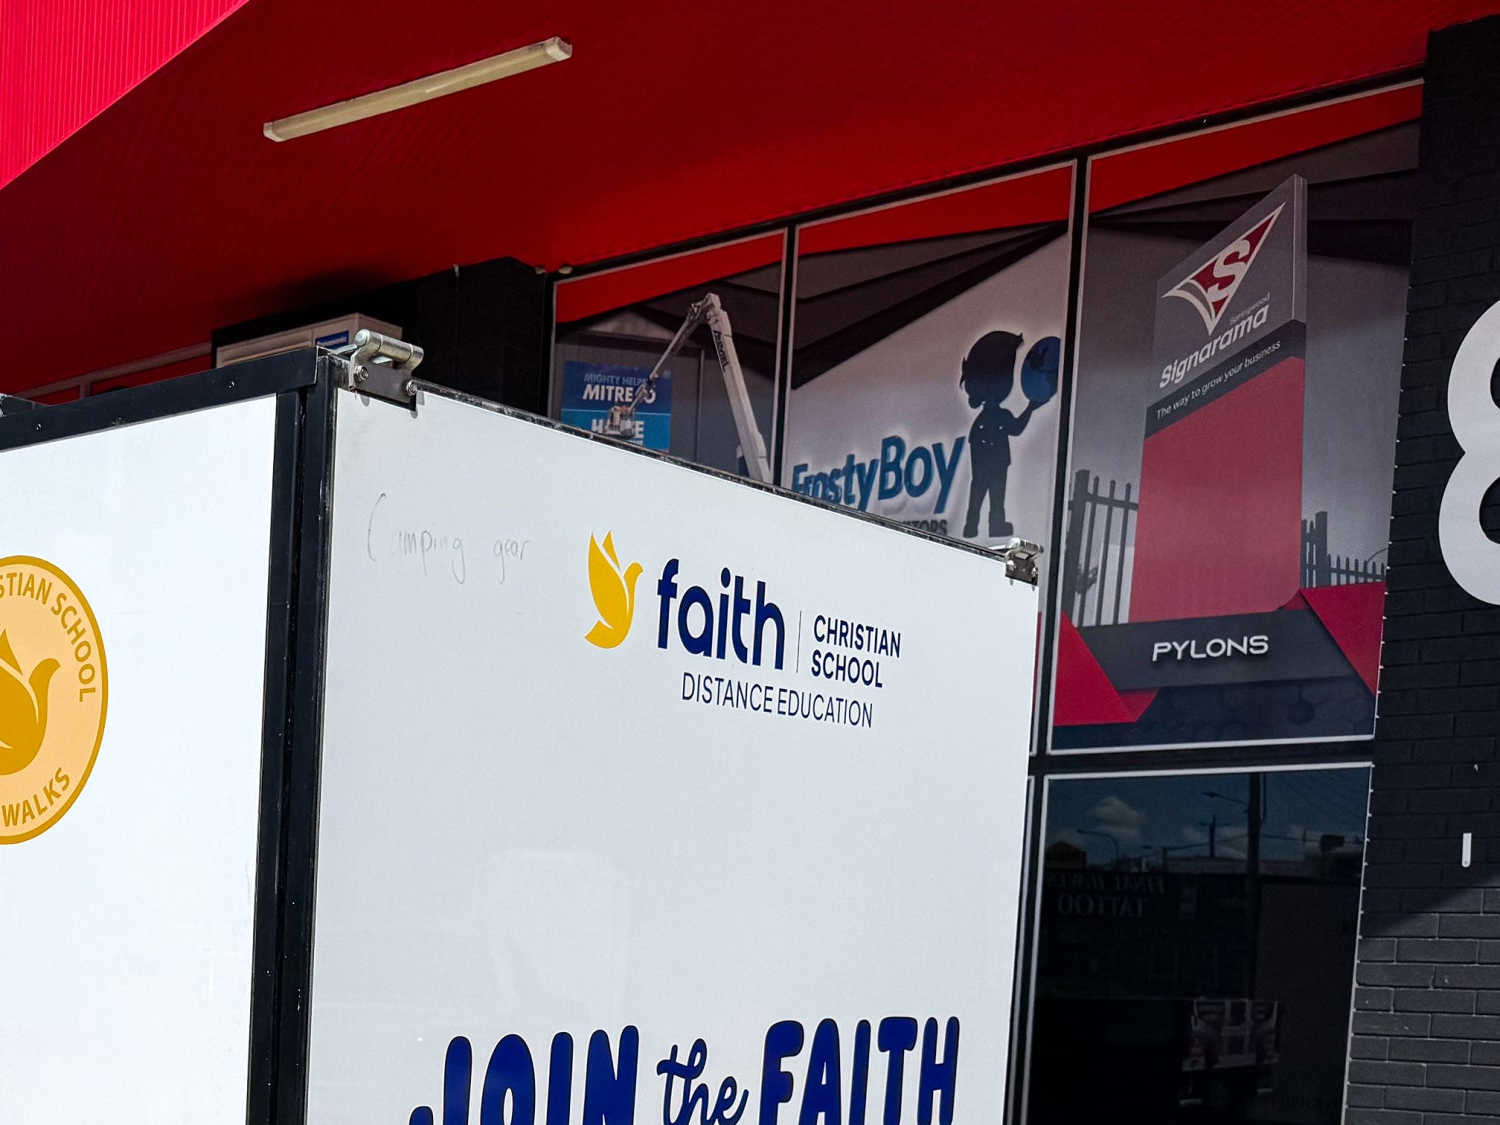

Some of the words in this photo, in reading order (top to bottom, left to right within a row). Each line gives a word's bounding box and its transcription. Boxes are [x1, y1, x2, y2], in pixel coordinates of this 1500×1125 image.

[1159, 304, 1269, 389] Signarama
[582, 383, 634, 403] MITRE
[584, 373, 620, 385] MIGHTY
[1156, 406, 1172, 420] The
[1173, 395, 1190, 411] way
[1191, 388, 1200, 400] to
[1201, 375, 1222, 396] grow
[1223, 363, 1243, 383] your
[1244, 340, 1281, 368] business
[657, 558, 786, 671] faith
[813, 614, 901, 658] CHRISTIAN
[51, 592, 97, 702] SCHOOL
[811, 649, 883, 688] SCHOOL
[1152, 634, 1269, 661] PYLONS
[682, 672, 774, 714] DISTANCE
[777, 688, 873, 729] EDUCATION
[1, 766, 71, 828] WALKS
